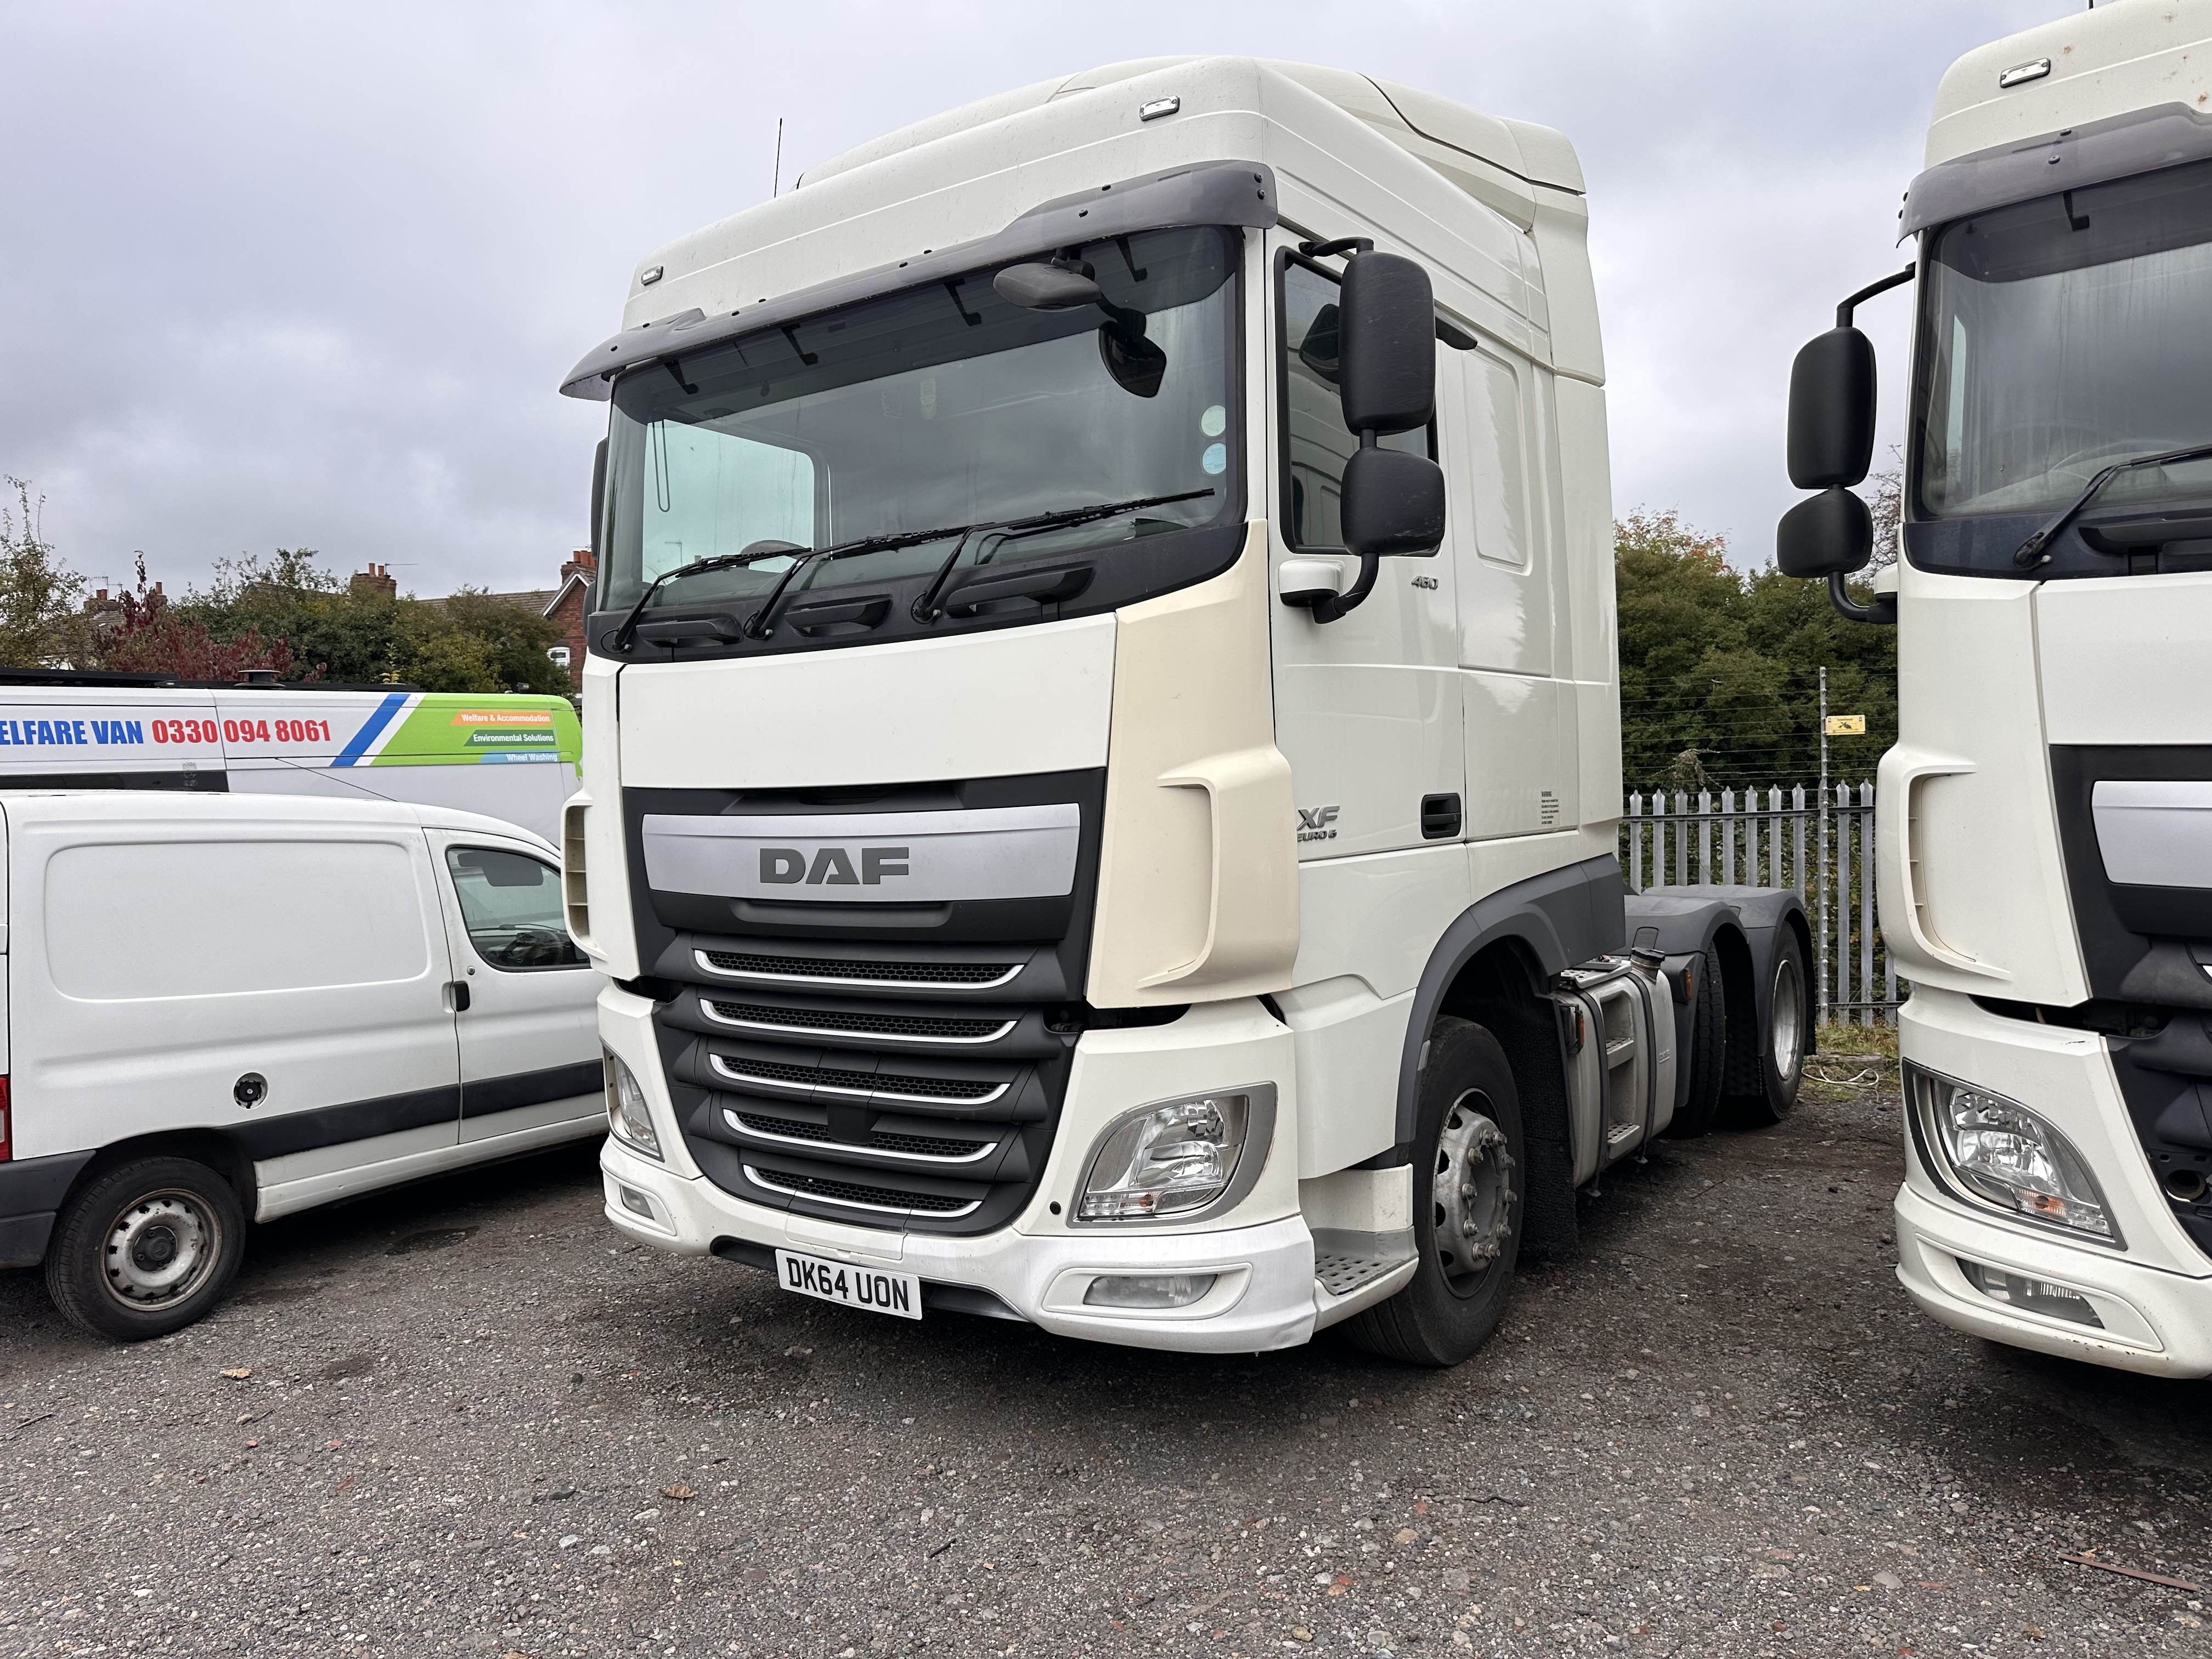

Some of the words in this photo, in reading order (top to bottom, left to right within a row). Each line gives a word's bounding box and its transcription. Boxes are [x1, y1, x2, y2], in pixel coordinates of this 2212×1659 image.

[1411, 575, 1438, 590] 460
[461, 714, 488, 722] Welfare
[91, 720, 144, 744] VAN
[151, 719, 218, 743] 0330
[223, 719, 270, 742] 094
[274, 720, 331, 742] 8061
[473, 733, 522, 742] Environmental
[506, 753, 527, 761] Wheel
[529, 753, 557, 761] Washing
[1296, 805, 1340, 831] XF
[1297, 830, 1328, 843] EURO
[1328, 829, 1337, 839] 6
[760, 847, 909, 884] DAF
[786, 1256, 849, 1299] DK64
[855, 1272, 910, 1312] UON
